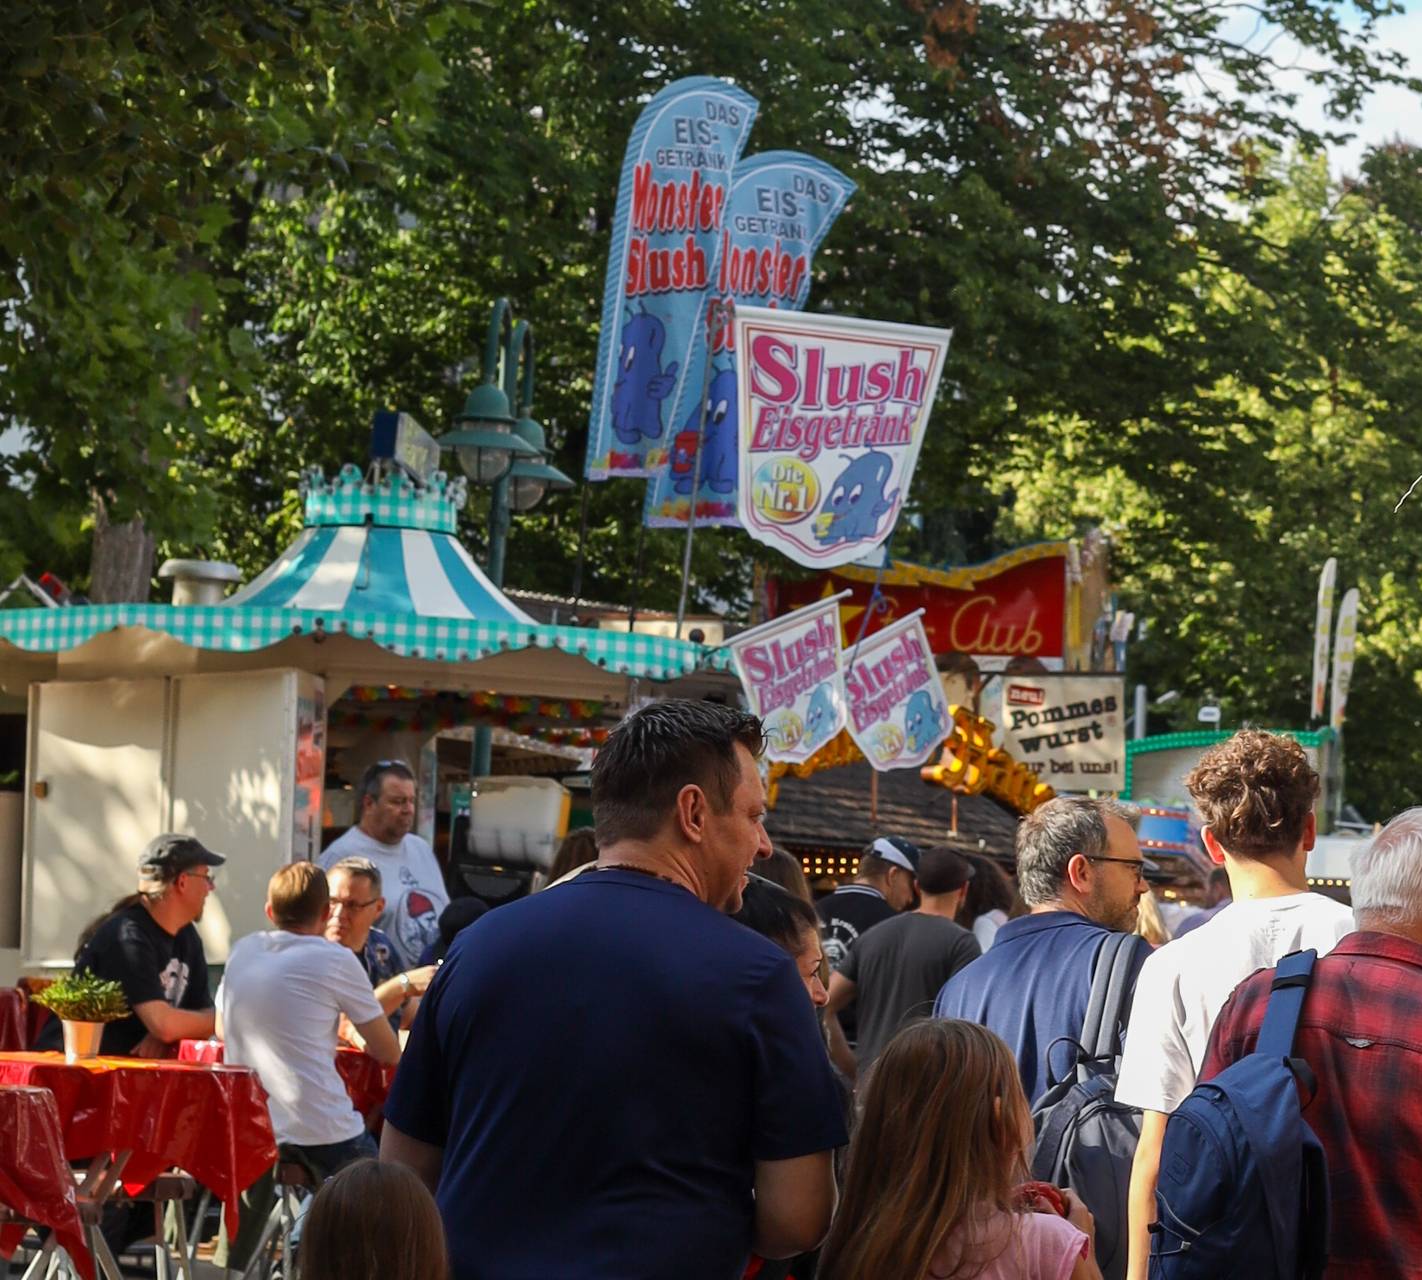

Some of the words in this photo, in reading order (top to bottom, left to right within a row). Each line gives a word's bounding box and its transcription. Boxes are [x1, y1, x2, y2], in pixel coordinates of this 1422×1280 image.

[705, 101, 739, 126] DAS
[674, 118, 720, 146] EIS-
[632, 162, 724, 232] Monster
[756, 187, 805, 217] EIS-
[793, 174, 831, 203] DAS
[624, 235, 708, 297] Slush
[751, 335, 926, 411] Slush
[749, 404, 916, 463] Eisgetränk
[771, 463, 805, 484] Die
[757, 482, 809, 513] Nr.1
[951, 596, 1043, 653] Club
[741, 614, 836, 685] Slush
[847, 631, 924, 703] Slush
[1010, 695, 1117, 731] Pommes
[1018, 720, 1103, 754] wurst
[1049, 758, 1074, 774] bei
[1079, 759, 1119, 774] uns!
